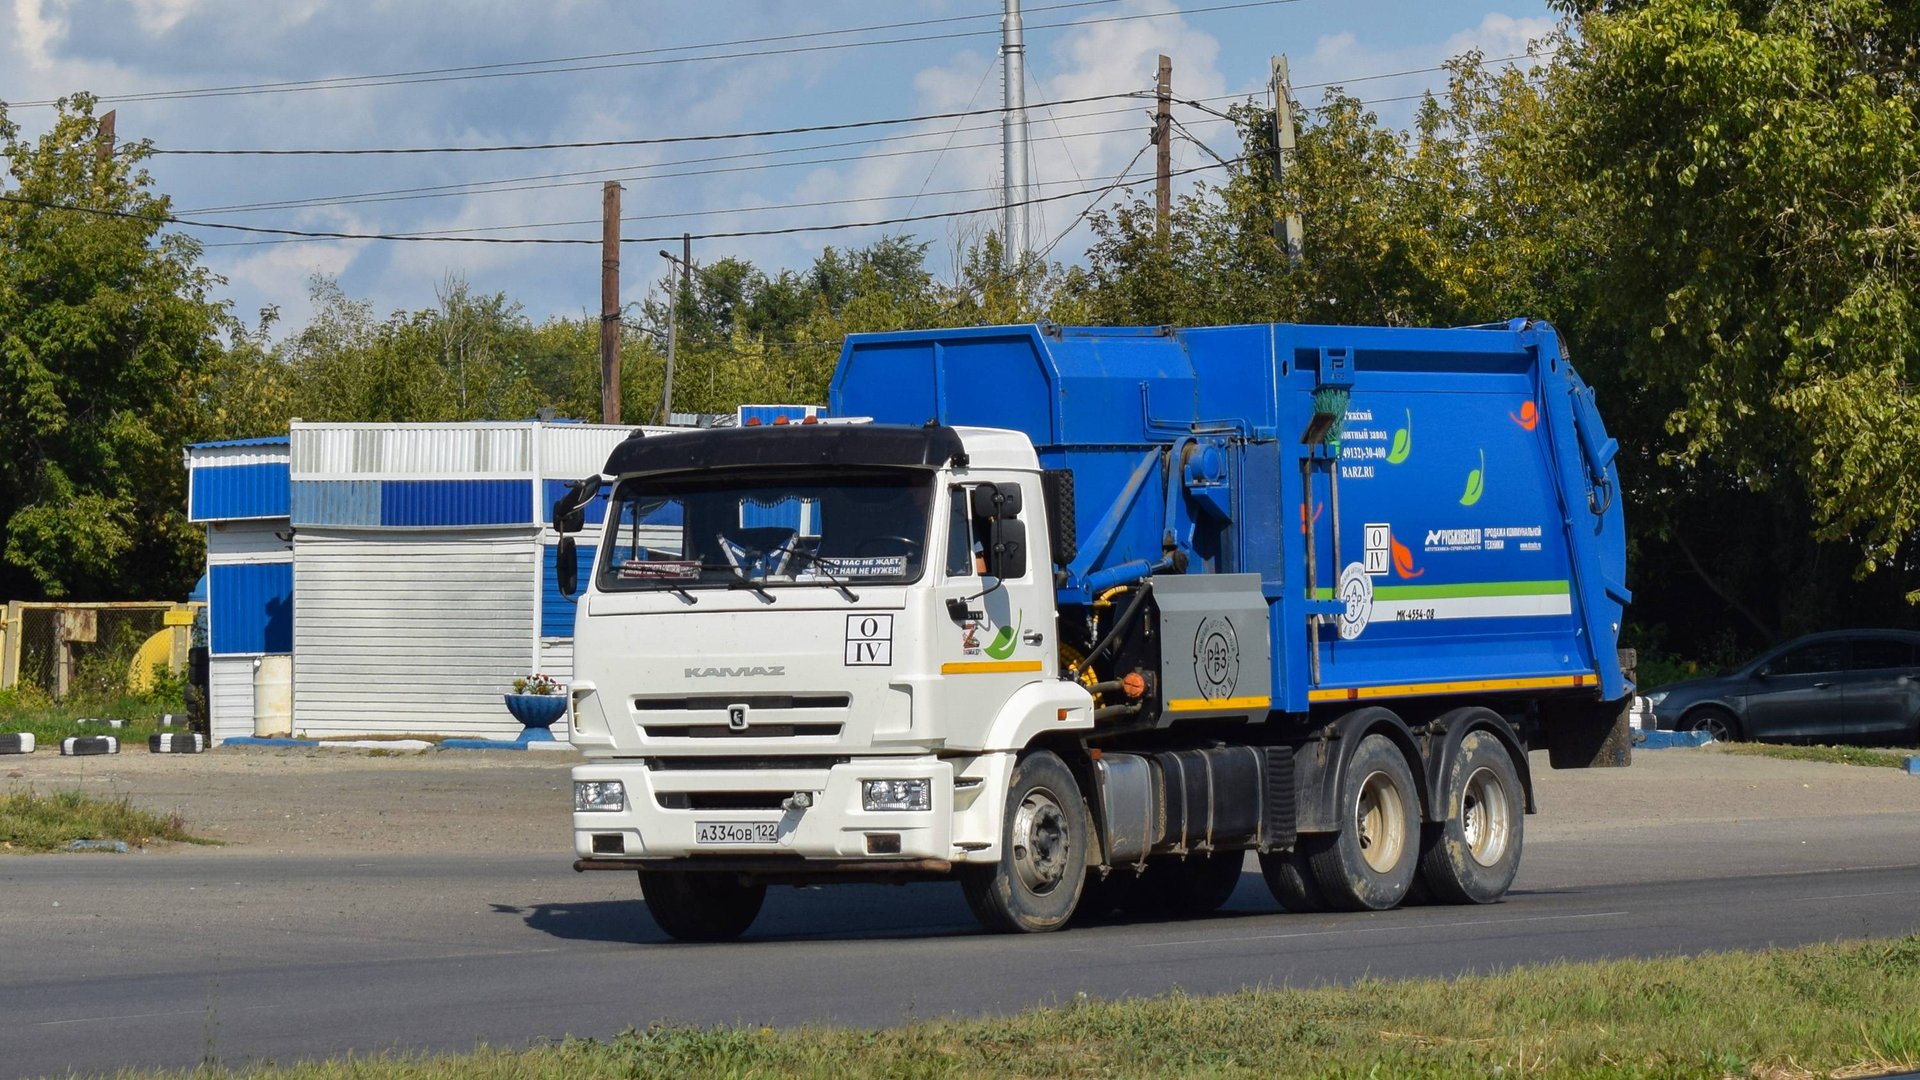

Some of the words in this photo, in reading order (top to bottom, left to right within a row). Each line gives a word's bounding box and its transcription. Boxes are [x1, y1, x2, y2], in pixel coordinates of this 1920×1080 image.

[1369, 430, 1388, 440] завод
[1342, 466, 1375, 478] RARZ.RU
[875, 558, 902, 566] ЖДЕТ,
[1370, 551, 1384, 570] IV
[859, 567, 870, 575] НЕ
[871, 566, 902, 575] НУЖЕН!
[860, 617, 879, 638] O
[855, 642, 883, 662] IV
[684, 666, 785, 678] KAMAZ
[701, 825, 752, 841] А334ОВ
[755, 824, 775, 837] 122
